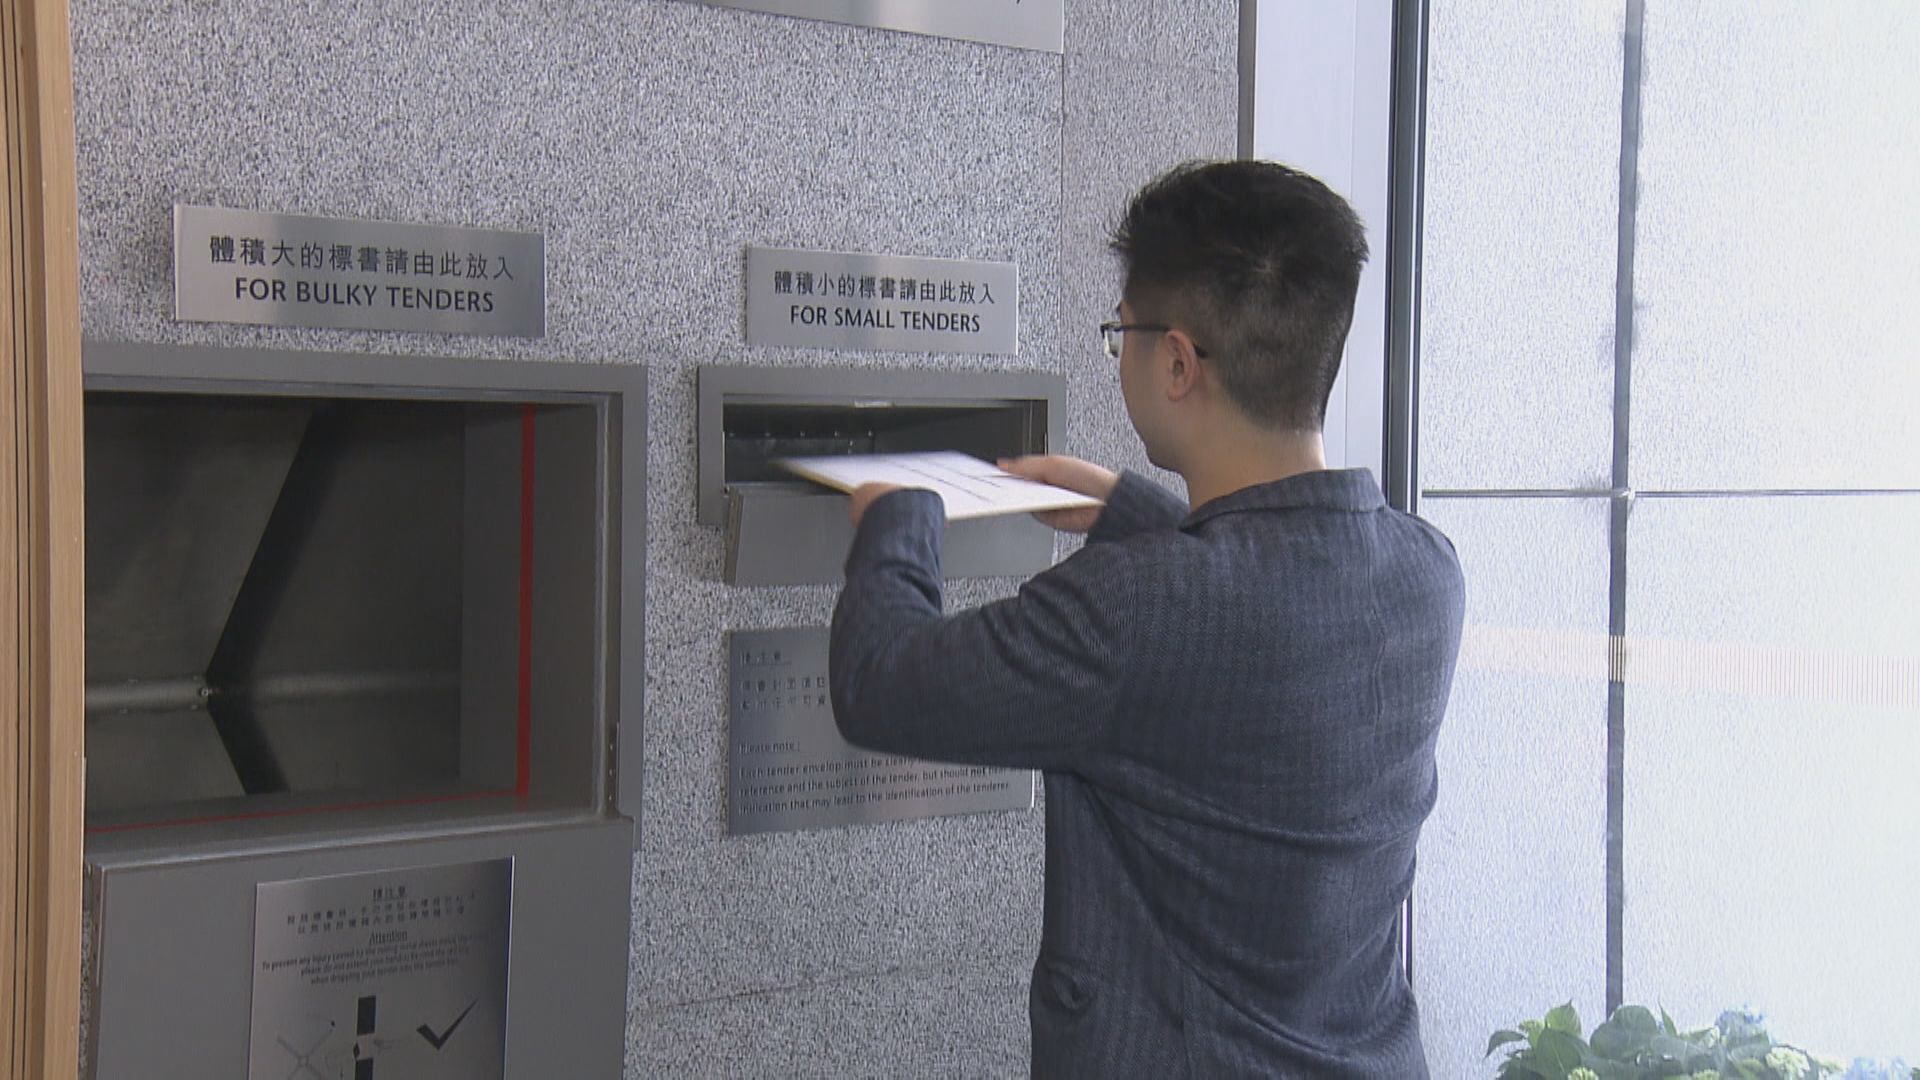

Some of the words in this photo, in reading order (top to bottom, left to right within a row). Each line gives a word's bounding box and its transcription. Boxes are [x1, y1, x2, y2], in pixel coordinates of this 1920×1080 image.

[209, 235, 513, 281] 體積大的標書請由此放入
[235, 277, 287, 303] FOR
[296, 281, 377, 308] BULKY
[385, 286, 494, 313] TENDERS
[774, 271, 995, 305] 體積小的標書請由此放入
[790, 304, 827, 326] FOR
[834, 307, 895, 329] SMALL
[900, 310, 980, 333] TENDERS
[767, 763, 799, 776] tender
[844, 759, 868, 769] must
[870, 757, 883, 767] be
[787, 781, 805, 793] and
[808, 779, 823, 791] the
[860, 775, 870, 785] of
[872, 774, 887, 785] the
[923, 770, 937, 781] but
[940, 768, 968, 779] should
[971, 767, 985, 777] not
[790, 799, 809, 810] that
[812, 798, 830, 809] may
[856, 793, 866, 804] to
[869, 791, 883, 803] the
[945, 784, 955, 795] of
[957, 782, 971, 795] the
